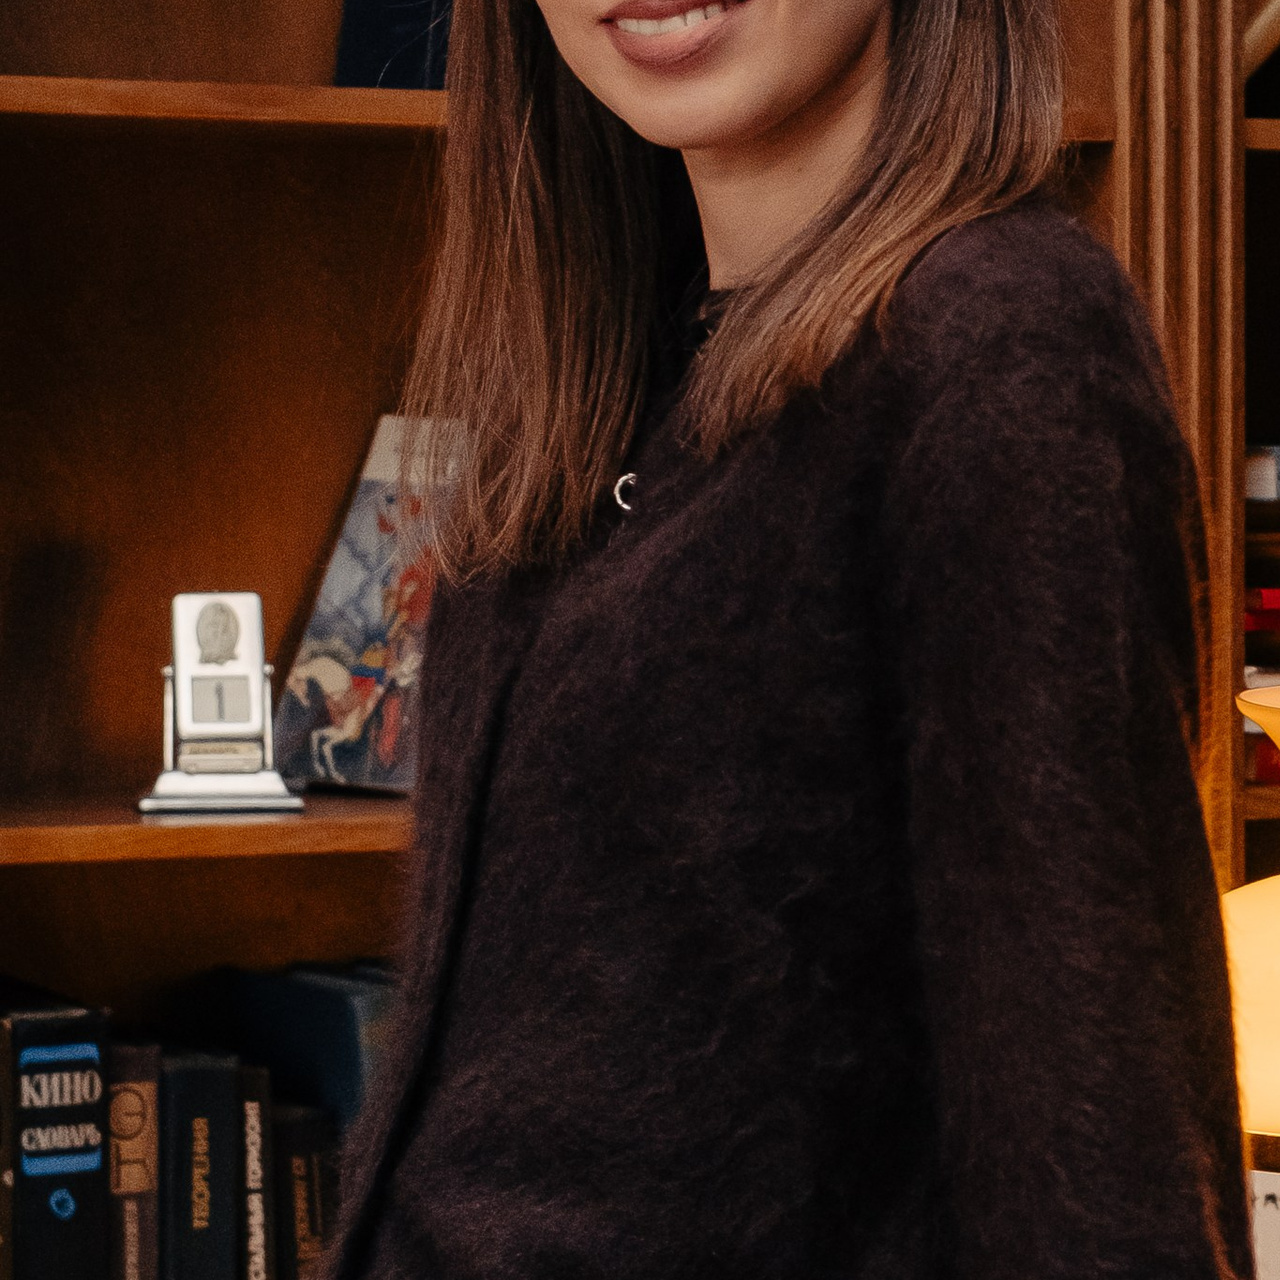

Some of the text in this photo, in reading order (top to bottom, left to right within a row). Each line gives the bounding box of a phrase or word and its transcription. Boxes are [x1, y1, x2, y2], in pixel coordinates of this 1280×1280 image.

[20, 1070, 103, 1108] КИНО
[20, 1123, 102, 1151] СЛОВАРЬ
[244, 1101, 264, 1190] ГОРИЗОНТ
[192, 1117, 211, 1230] ТВОРЕНИЯ
